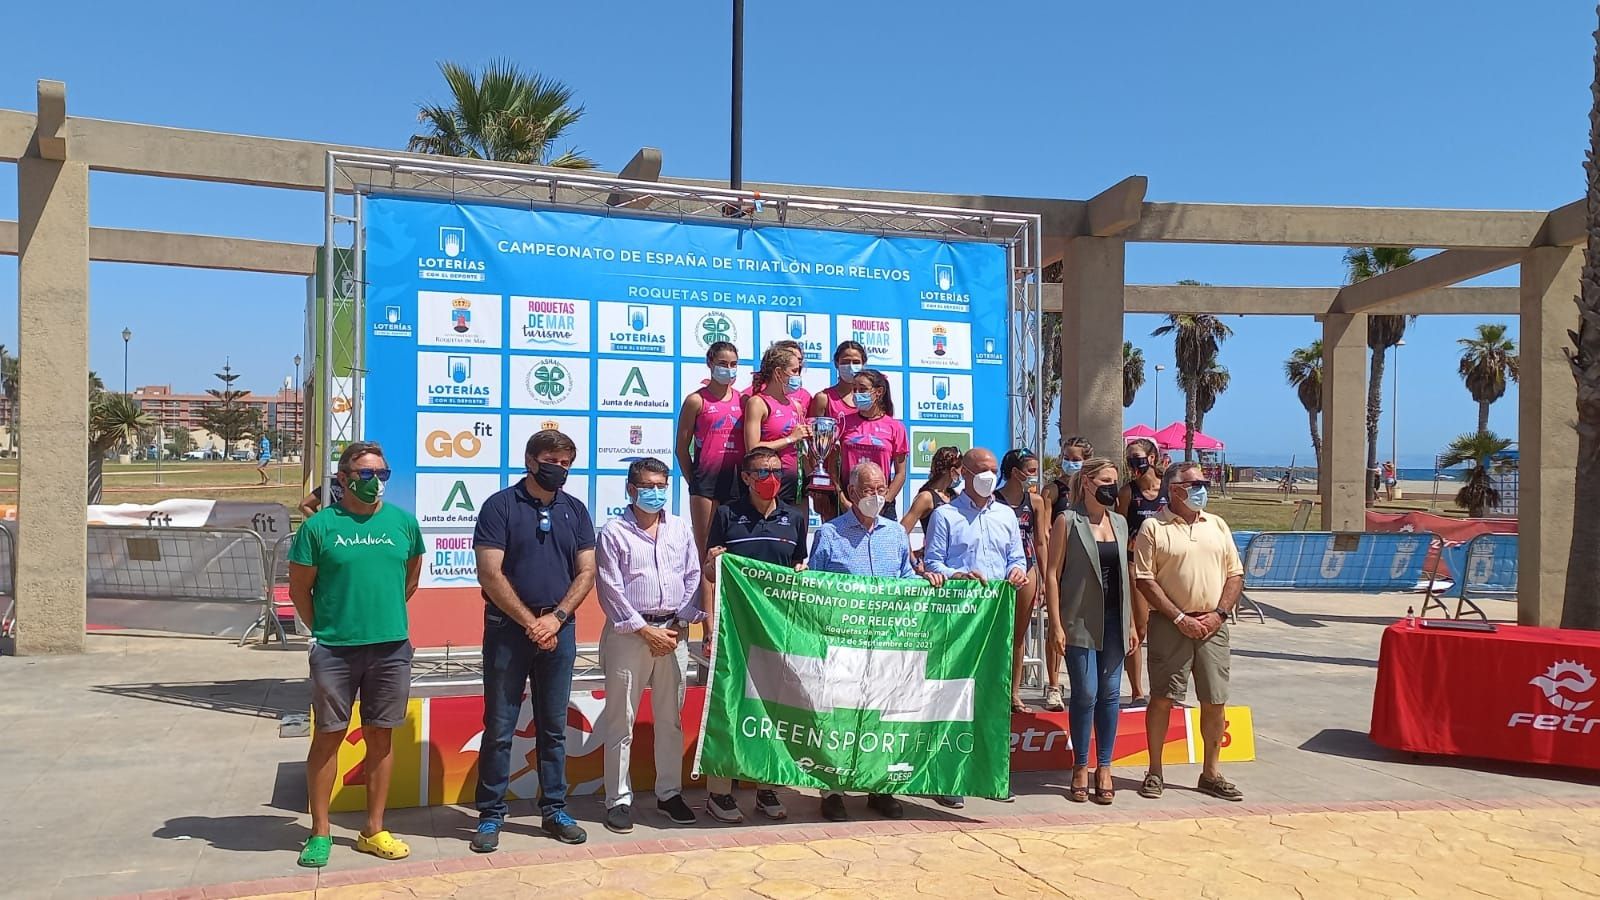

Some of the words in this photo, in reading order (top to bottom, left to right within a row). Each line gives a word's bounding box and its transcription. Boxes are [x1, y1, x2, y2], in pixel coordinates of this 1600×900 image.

[418, 257, 485, 271] LOTERÍAS
[497, 240, 615, 261] CAMPEONATO
[620, 250, 641, 263] DE
[646, 252, 708, 268] ESPAÑA
[712, 256, 733, 269] DE
[737, 258, 811, 274] TRIATLÓN
[815, 263, 844, 276] POR
[849, 266, 911, 281] RELEVOS
[628, 286, 709, 302] ROQUETAS
[713, 291, 732, 303] DE
[736, 293, 766, 305] MAR
[770, 295, 802, 307] 2021
[920, 291, 970, 303] LOTERÍAS
[528, 300, 575, 314] ROQUETAS
[373, 322, 412, 331] LOTERÍAS
[528, 314, 544, 328] DE
[546, 315, 574, 330] MAR
[852, 319, 890, 332] ROQUETAS
[521, 324, 573, 339] turismo
[610, 332, 666, 343] LOTERÍAS
[866, 332, 890, 346] MAR
[428, 384, 490, 395] LOTERÍAS
[918, 401, 964, 411] LOTERÍAS
[425, 430, 481, 458] GO
[473, 421, 493, 437] fit
[251, 513, 278, 533] fit
[421, 514, 445, 522] Junta
[446, 514, 456, 522] de
[334, 532, 396, 547] Andalucía
[435, 537, 473, 550] ROQUET
[435, 551, 452, 566] DE
[454, 551, 475, 566] MA
[740, 566, 773, 581] COPA
[776, 573, 799, 586] DEL
[801, 576, 825, 589] REY
[826, 580, 834, 590] Y
[836, 582, 867, 594] COPA
[869, 584, 885, 595] DE
[887, 585, 901, 596] LA
[904, 586, 936, 597] REINA
[938, 588, 951, 598] DE
[763, 586, 847, 608] CAMPEONATO
[850, 598, 866, 609] DE
[868, 600, 911, 611] ESPAÑA
[913, 602, 929, 612] DE
[841, 614, 866, 625] POR
[868, 616, 918, 627] RELEVOS
[825, 625, 862, 635] Roquetas
[741, 716, 823, 749] GREEN
[827, 730, 909, 753] SPORT
[914, 732, 975, 754] FLAG
[886, 772, 912, 782] ADESP
